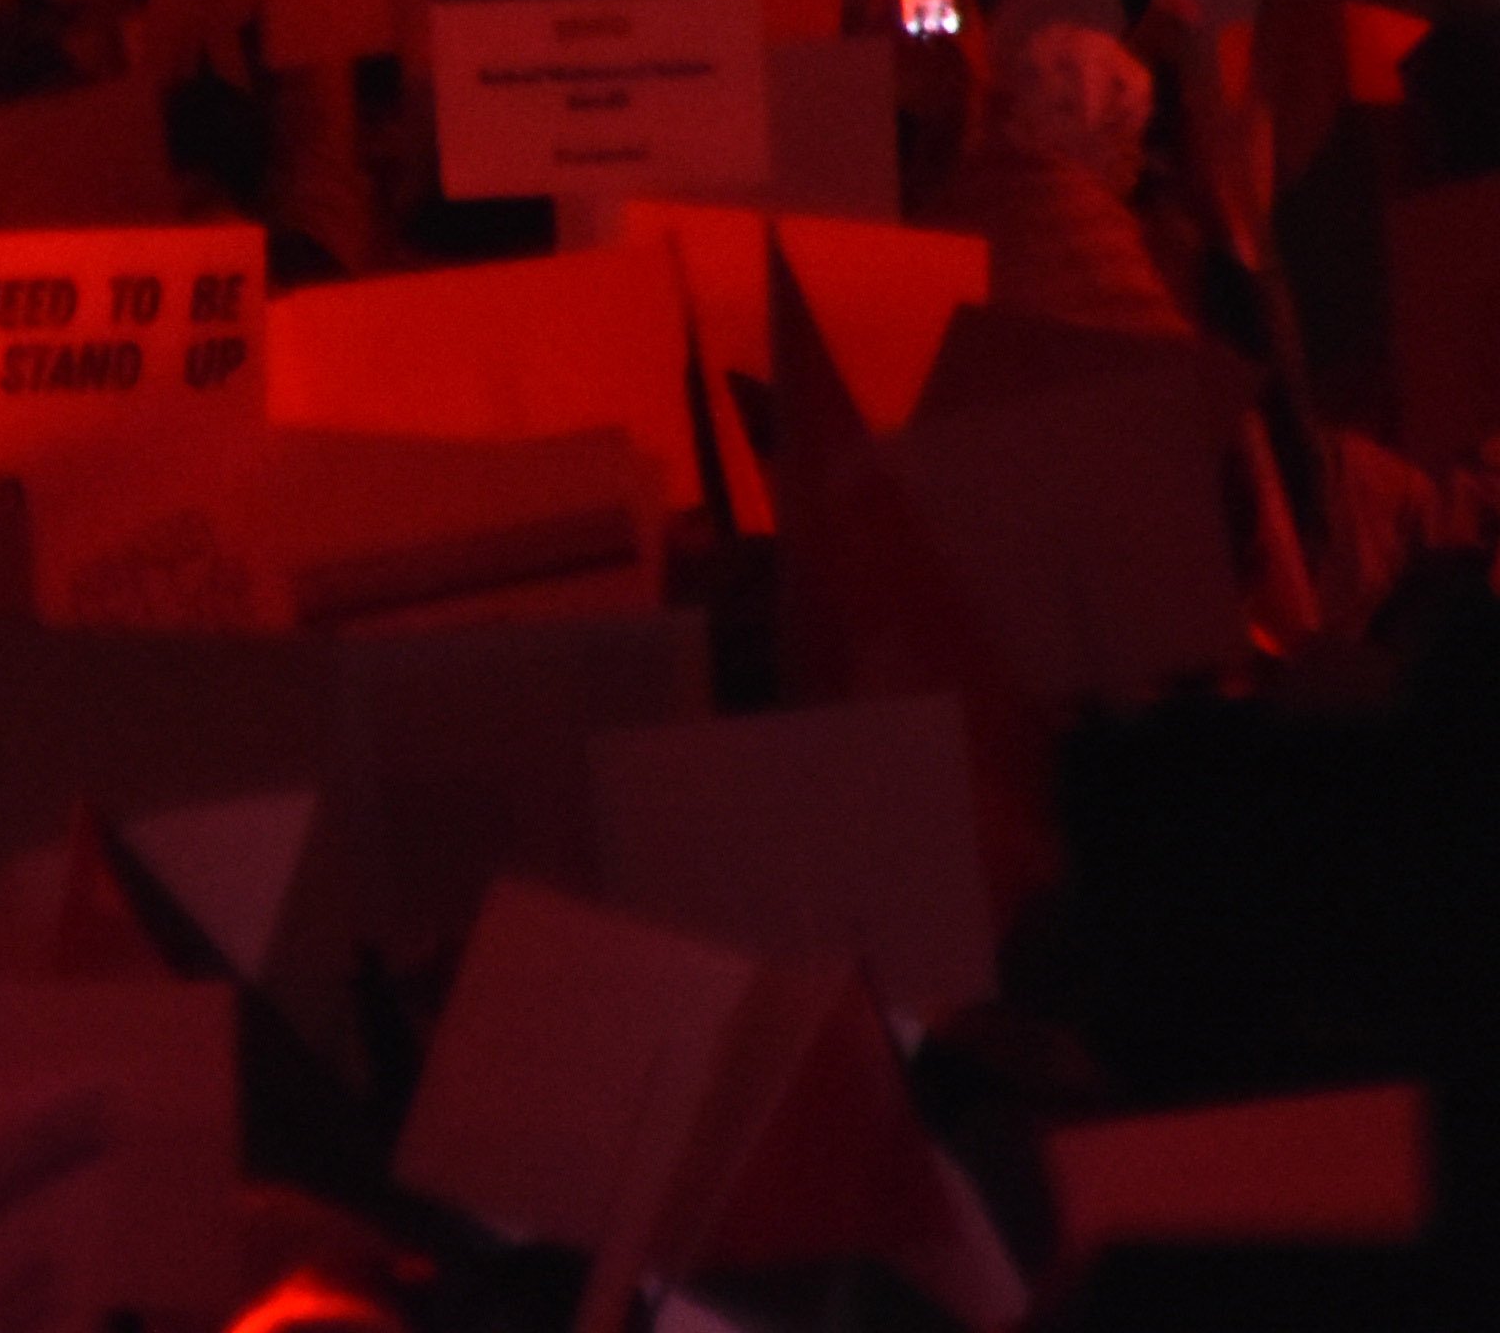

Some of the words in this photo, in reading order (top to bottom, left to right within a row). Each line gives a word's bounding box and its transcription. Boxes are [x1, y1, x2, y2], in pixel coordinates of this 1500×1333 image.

[110, 275, 161, 325] TO
[190, 273, 246, 323] BE
[1, 341, 143, 393] STAND
[185, 337, 247, 389] UP
